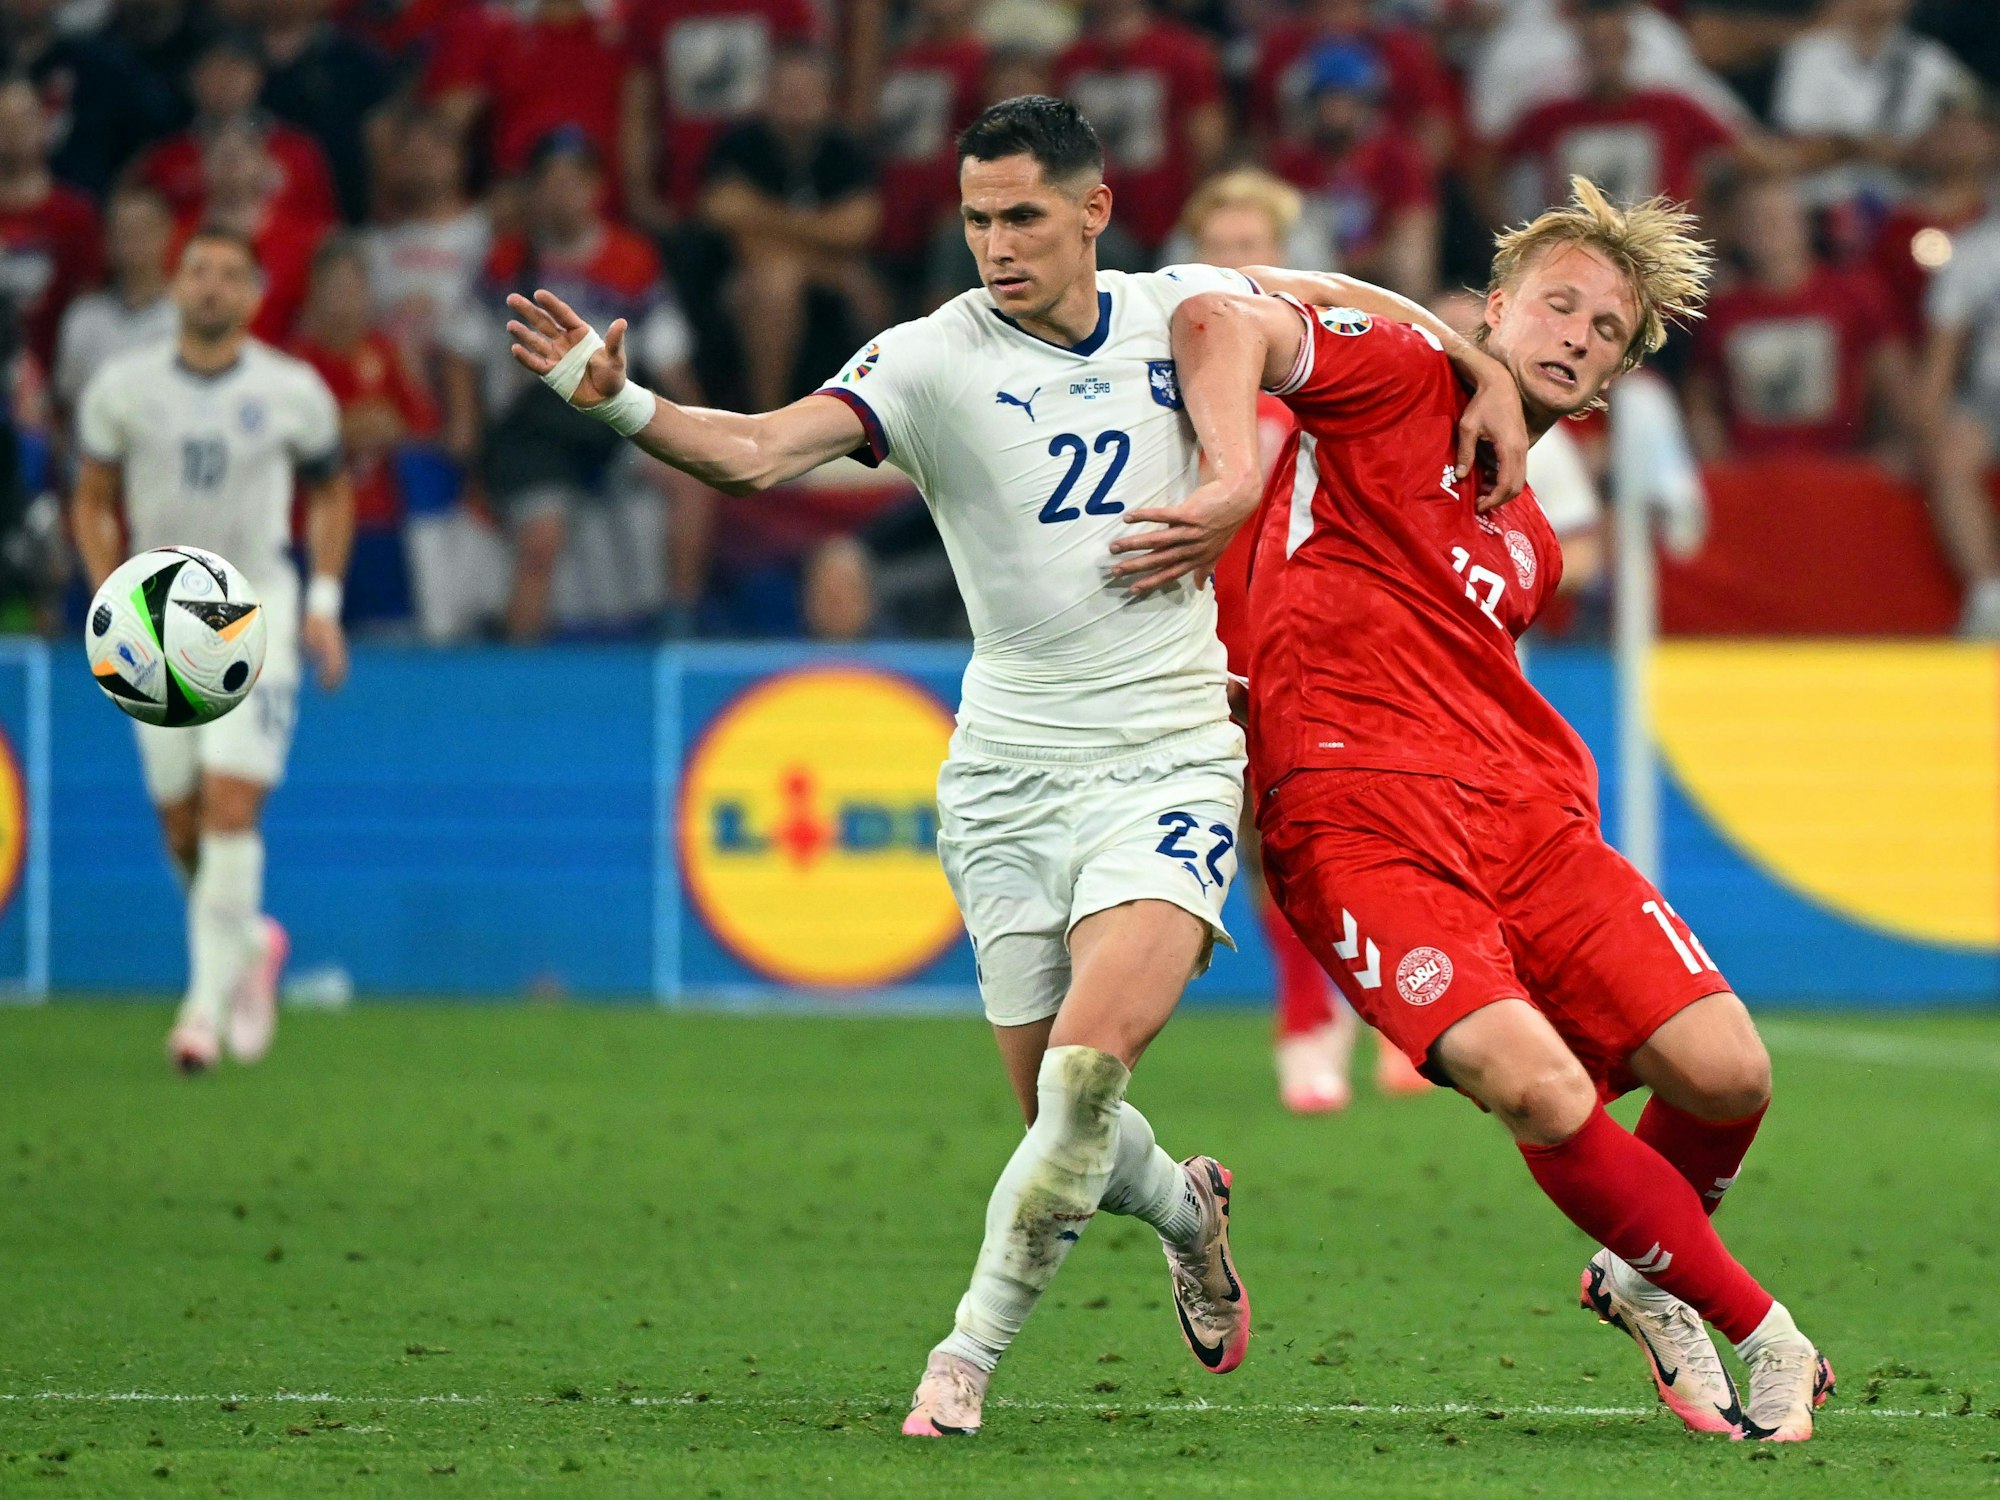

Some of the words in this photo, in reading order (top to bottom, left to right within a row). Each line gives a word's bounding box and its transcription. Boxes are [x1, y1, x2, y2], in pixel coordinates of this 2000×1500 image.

[1039, 430, 1130, 524] 22
[1155, 811, 1234, 888] 22
[1406, 959, 1440, 991] DBU
